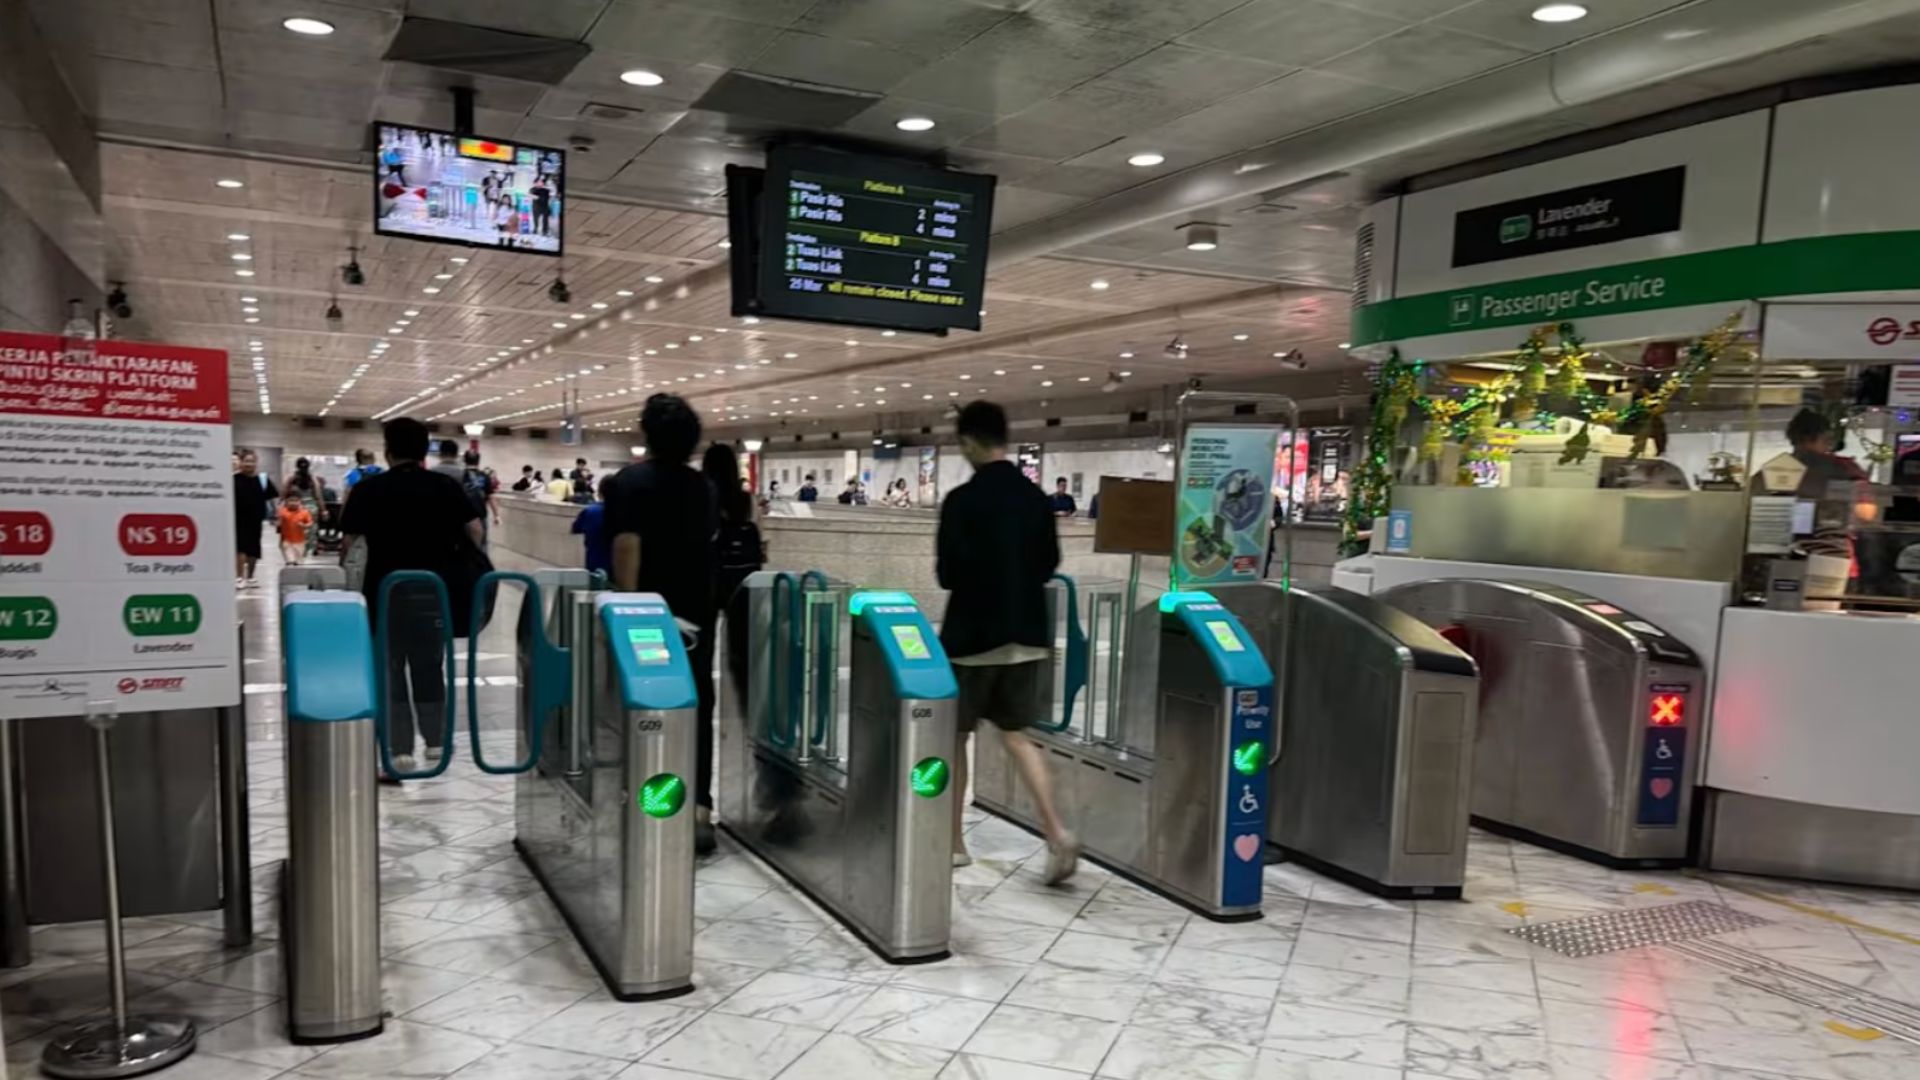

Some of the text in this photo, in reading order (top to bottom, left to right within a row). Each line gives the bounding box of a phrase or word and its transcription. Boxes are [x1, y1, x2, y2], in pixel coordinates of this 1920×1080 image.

[800, 190, 826, 205] Pasir
[827, 194, 844, 208] Ris
[917, 208, 927, 220] 2
[933, 211, 958, 224] mins
[1538, 197, 1612, 225] Lavender
[799, 205, 825, 220] Pasir
[825, 209, 843, 222] Ris
[915, 223, 925, 235] 4
[932, 226, 956, 238] mins
[786, 243, 796, 256] 2
[821, 246, 843, 260] Link
[913, 259, 921, 271] 1
[928, 261, 948, 274] min
[785, 258, 795, 271] 2
[820, 260, 842, 275] Link
[911, 273, 920, 285] 4
[927, 275, 951, 288] mins
[789, 277, 824, 292] 25 Mar
[1480, 275, 1666, 318] Passenger Service
[51, 366, 104, 384] SKRIN
[107, 370, 197, 390] PLATFORM
[14, 524, 44, 543] 18
[126, 526, 190, 545] NS 19
[124, 562, 195, 576] Toa Payoh
[21, 608, 52, 627] 12
[130, 606, 194, 624] EW 11
[133, 642, 194, 654] Lavender
[638, 720, 663, 732] G09
